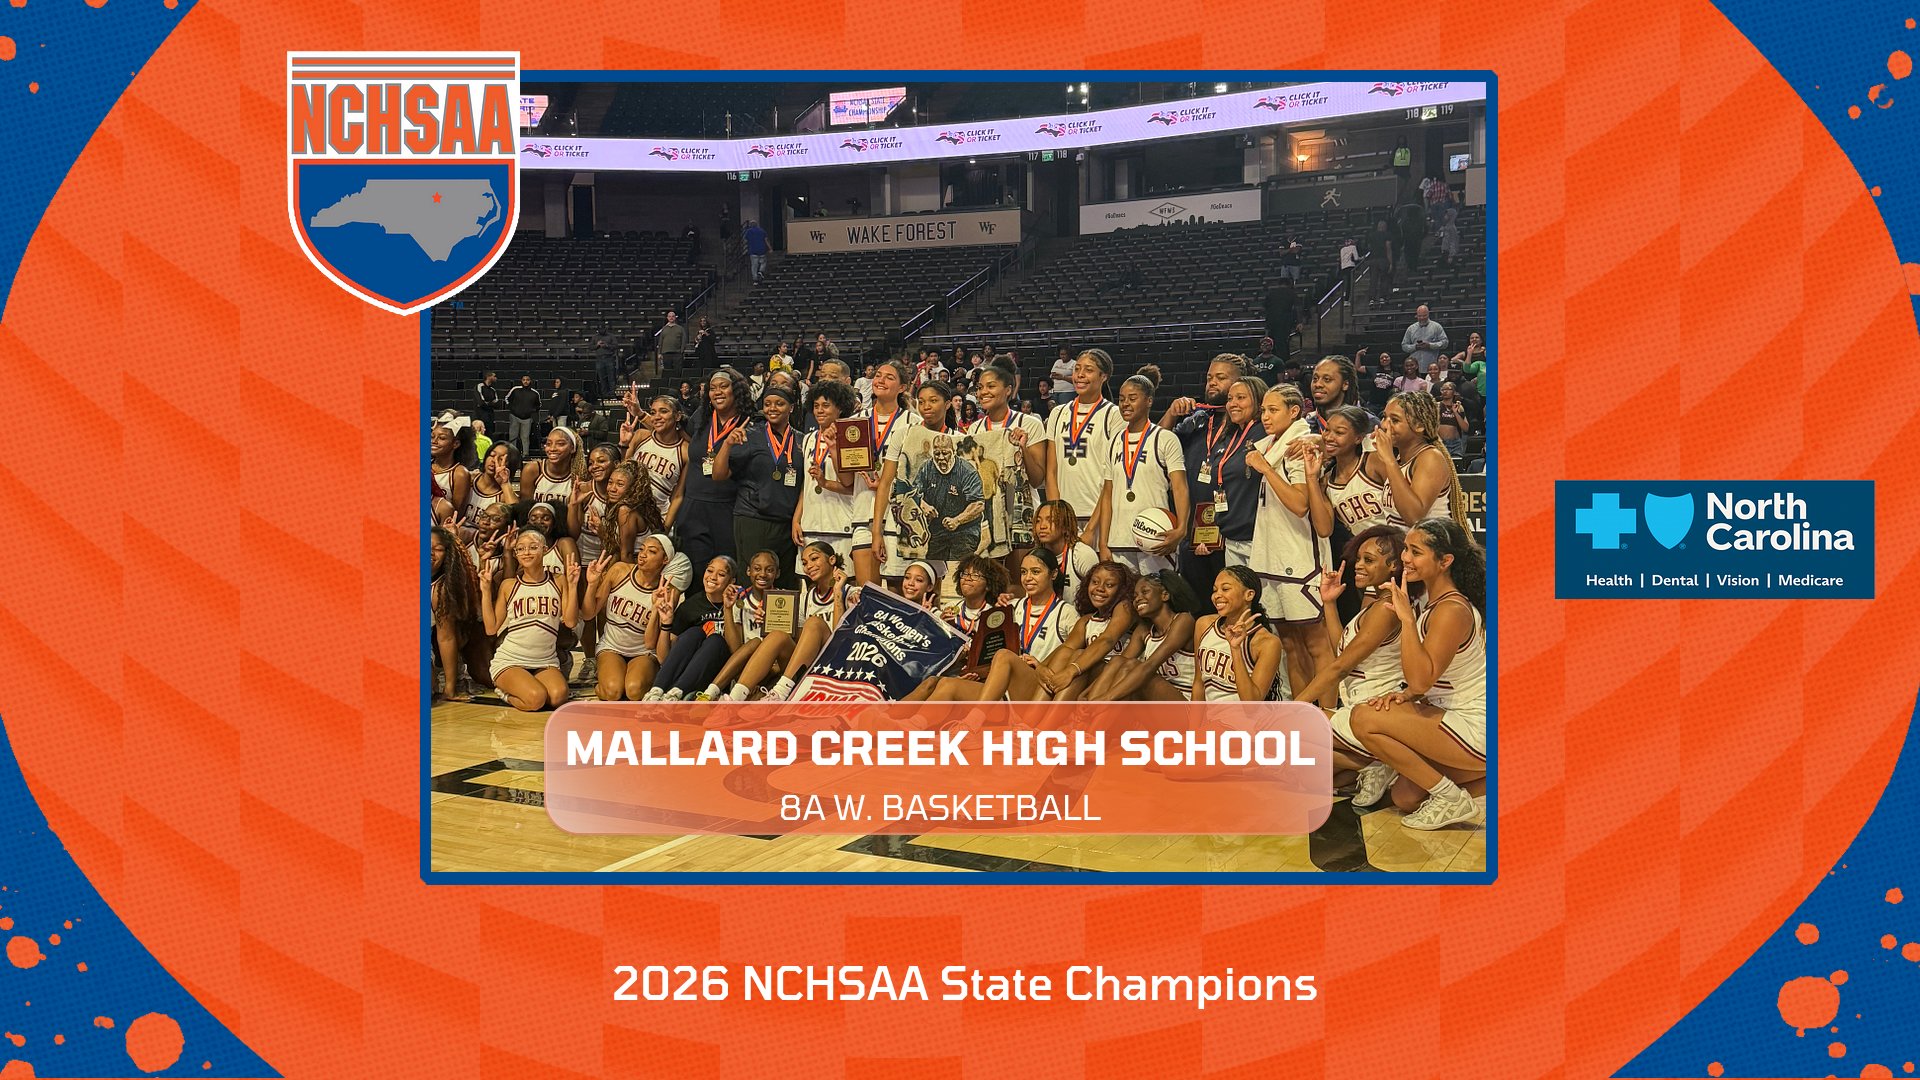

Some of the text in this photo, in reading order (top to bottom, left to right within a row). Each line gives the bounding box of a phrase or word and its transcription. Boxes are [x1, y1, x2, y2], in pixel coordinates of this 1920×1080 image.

[1420, 82, 1448, 92] TICKET
[1288, 90, 1320, 101] CLICK IT
[1288, 97, 1328, 108] OR TICKET
[1180, 108, 1201, 116] CLICK
[1440, 104, 1454, 115] 119
[1192, 112, 1216, 121] TICKET
[1068, 120, 1088, 128] CLICK
[1079, 126, 1102, 134] TICKET
[978, 134, 1001, 142] TICKET
[1028, 152, 1038, 161] 117
[1056, 150, 1068, 158] 118
[726, 172, 737, 181] 116
[752, 170, 762, 179] 117
[847, 220, 957, 244] WAKE FOREST
[978, 221, 996, 234] WF
[810, 230, 826, 244] WF
[636, 451, 676, 480] MCHS
[1338, 492, 1382, 524] CHS
[513, 596, 559, 619] MCHS
[873, 609, 932, 648] 8A Women's
[846, 642, 888, 668] 2026
